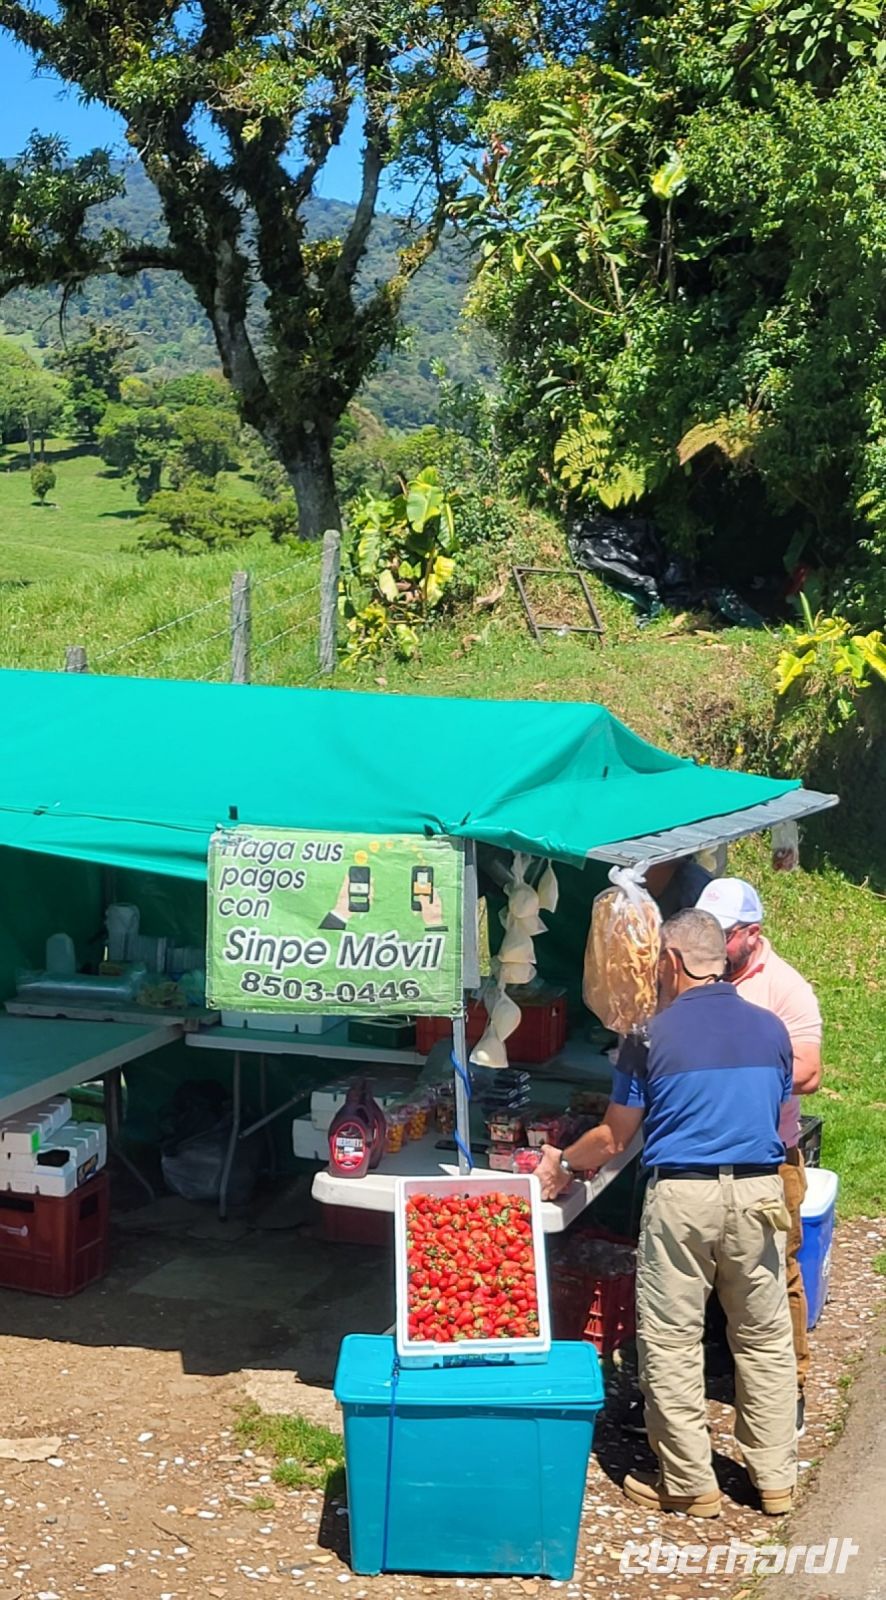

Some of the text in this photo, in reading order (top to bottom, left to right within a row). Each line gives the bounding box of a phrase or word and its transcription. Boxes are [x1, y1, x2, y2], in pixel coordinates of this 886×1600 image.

[302, 843, 343, 861] sus
[220, 867, 305, 893] pagos
[218, 897, 270, 917] con
[225, 929, 443, 969] Sinpe Móvil
[241, 972, 420, 1003] 8503-0446
